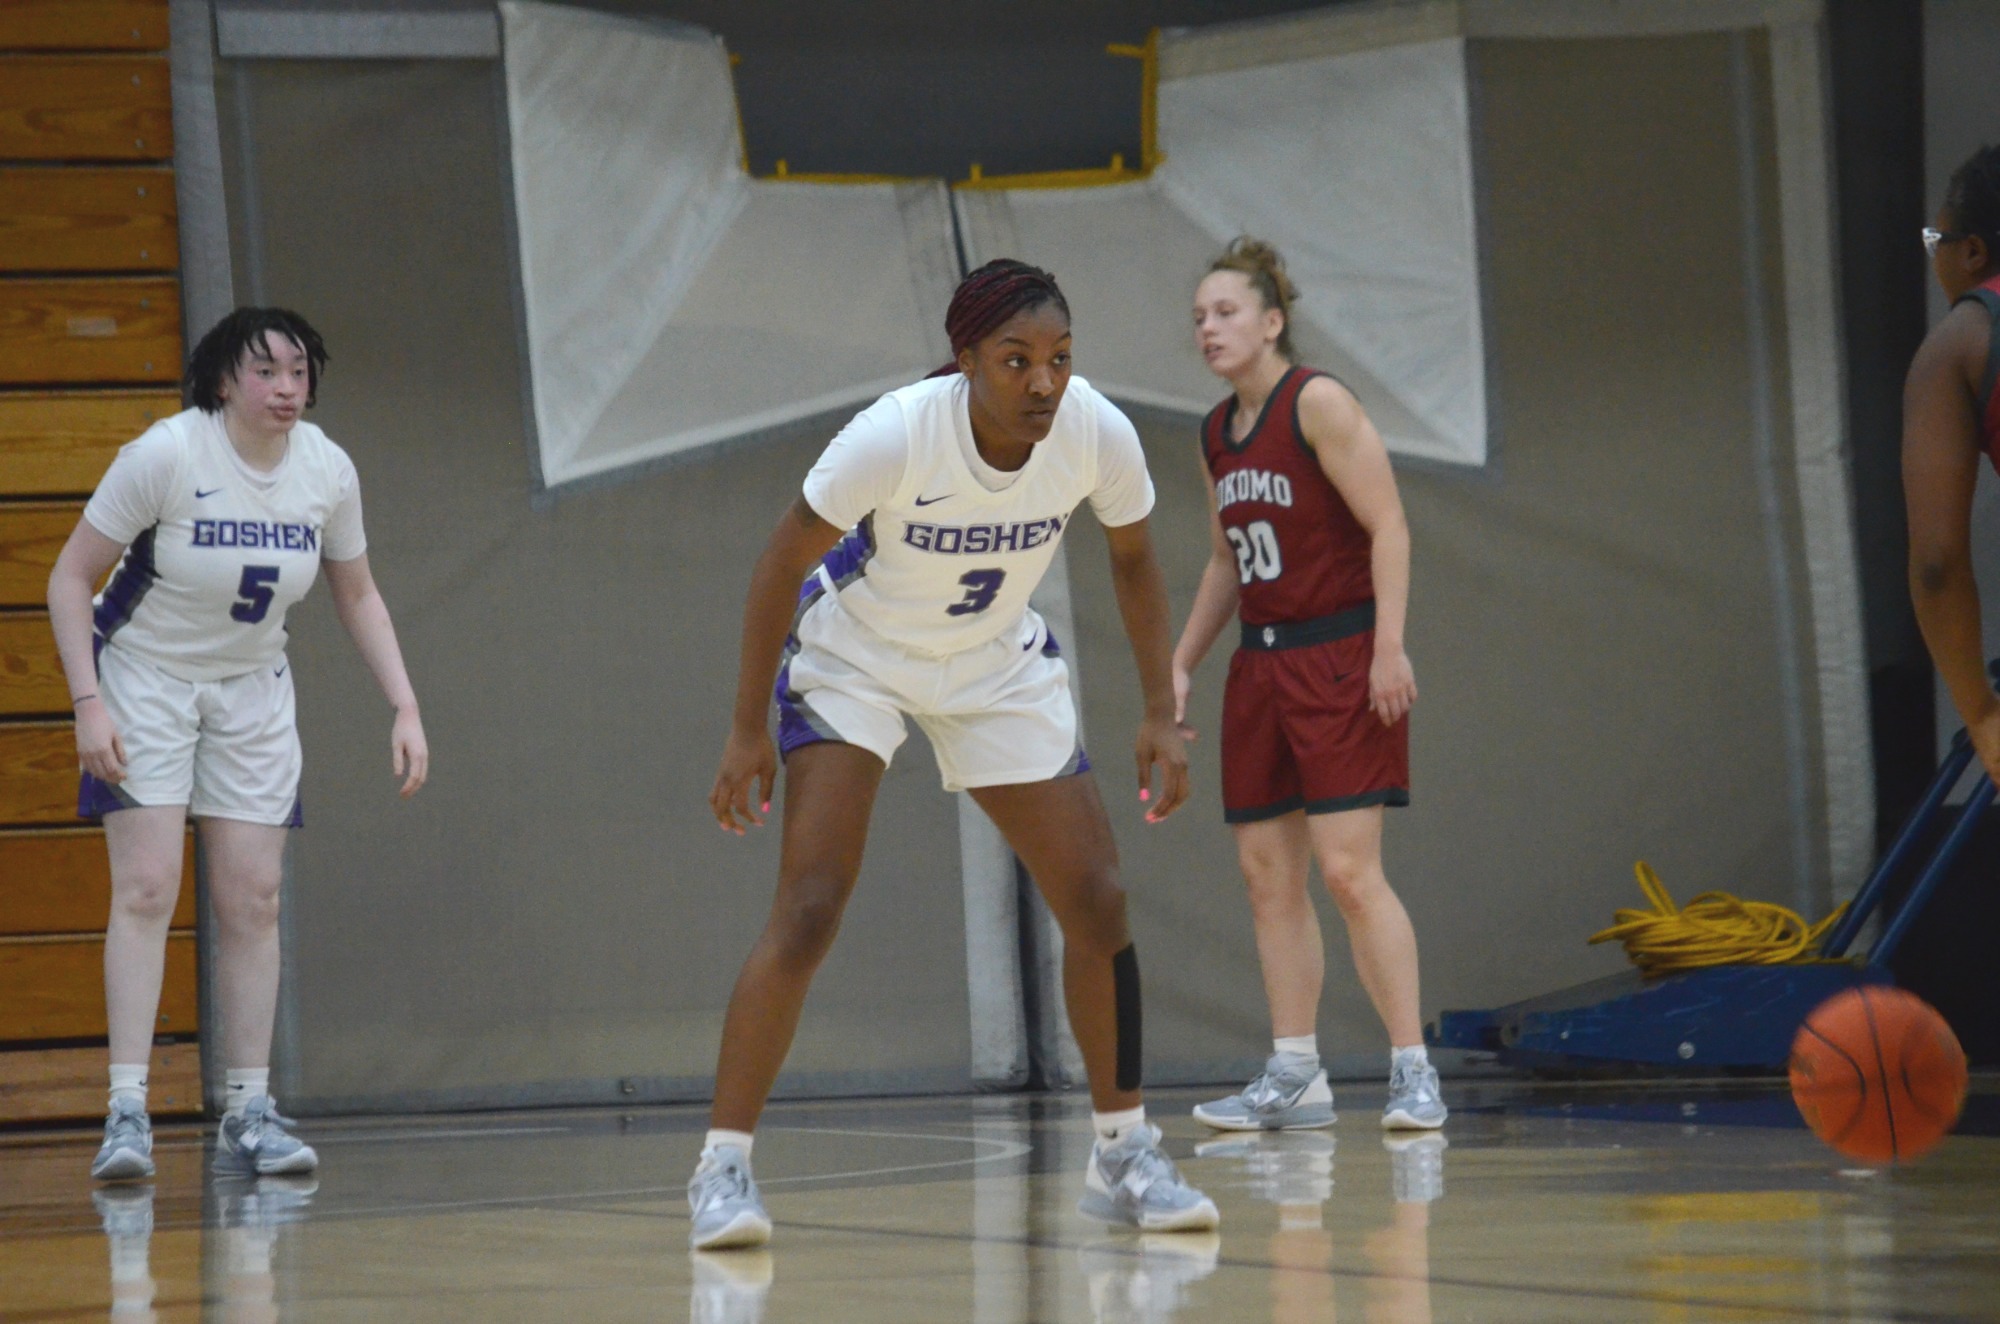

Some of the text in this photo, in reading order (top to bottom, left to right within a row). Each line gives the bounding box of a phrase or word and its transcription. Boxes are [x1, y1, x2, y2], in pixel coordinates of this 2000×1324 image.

[192, 519, 317, 551] GOSHEN
[901, 513, 1068, 555] GOSHEN
[1227, 520, 1282, 584] 20
[229, 564, 280, 624] 5
[945, 567, 1007, 616] 3
